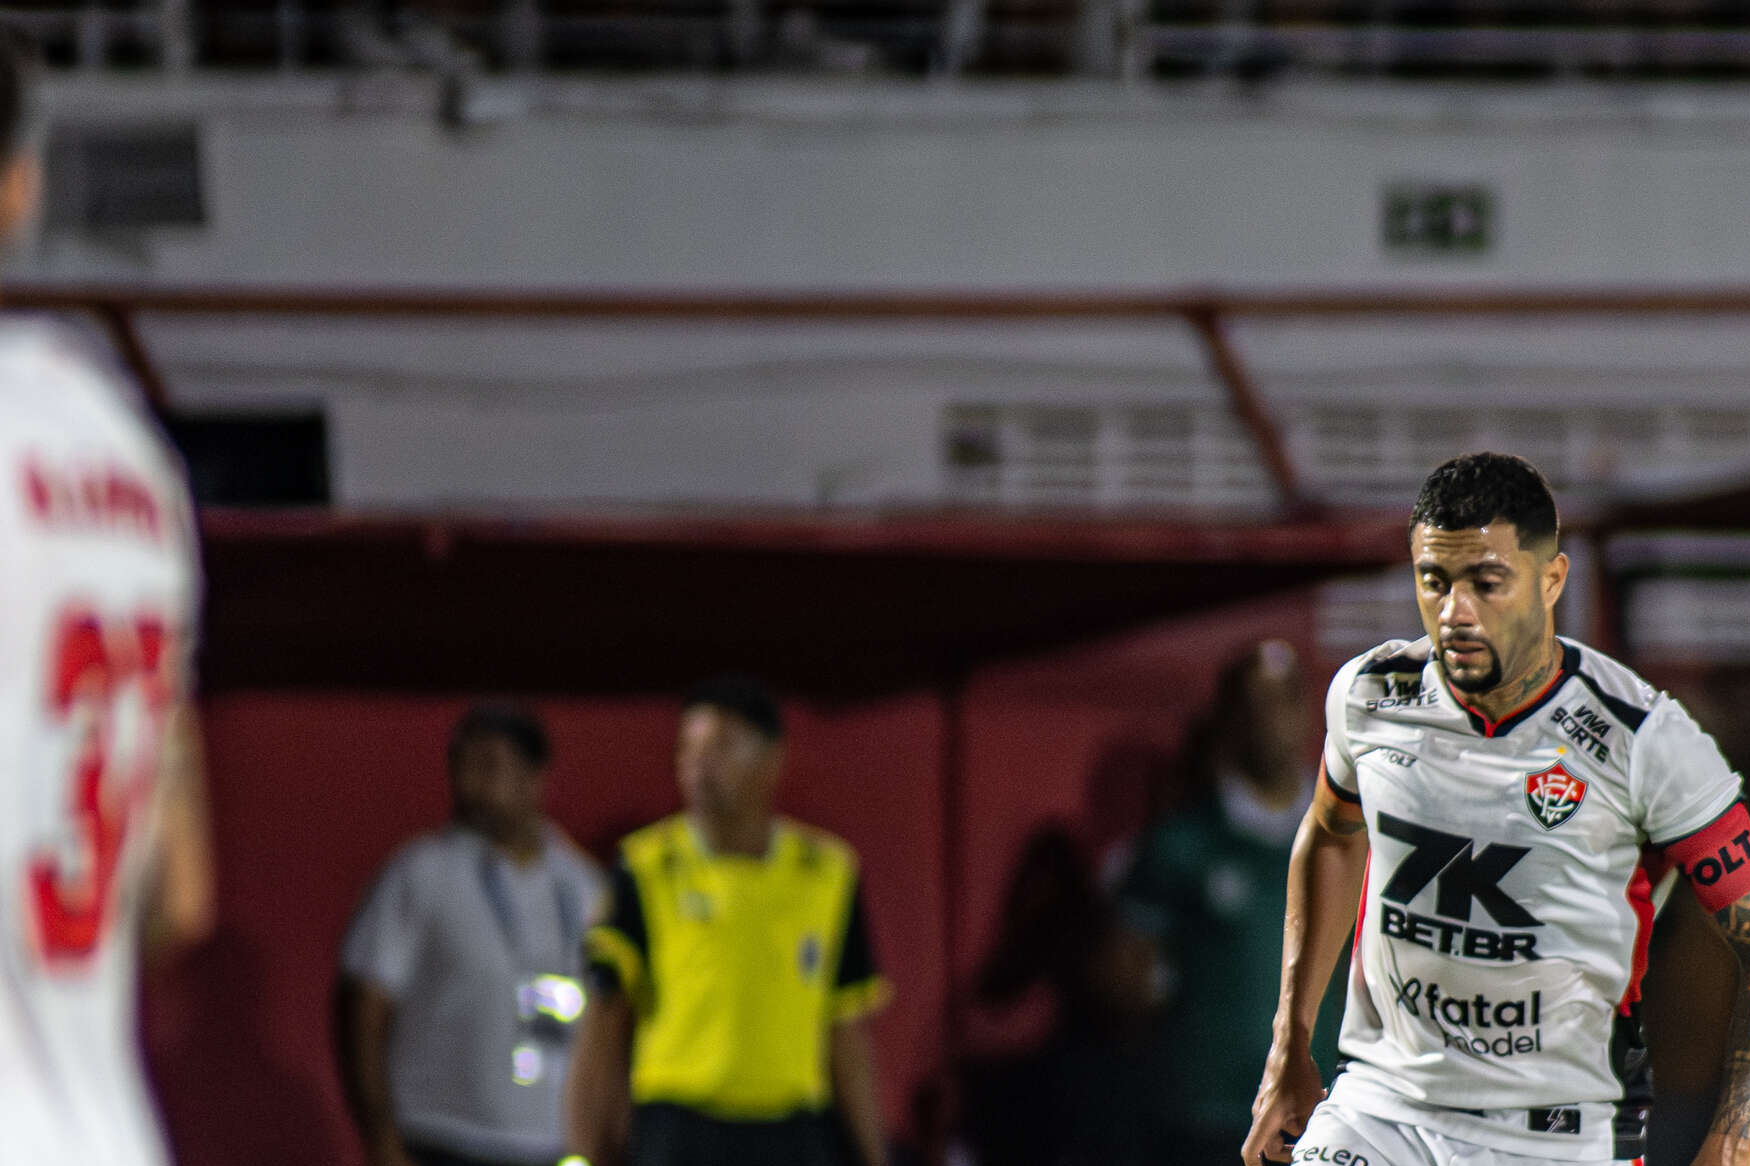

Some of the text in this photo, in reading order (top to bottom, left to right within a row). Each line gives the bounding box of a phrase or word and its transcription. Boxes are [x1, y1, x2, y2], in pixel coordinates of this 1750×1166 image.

[1550, 706, 1610, 764] SORTE
[1573, 704, 1611, 739] VIVA
[1376, 810, 1546, 928] 7K
[1380, 901, 1544, 962] BET.BR
[1425, 983, 1541, 1028] fatal
